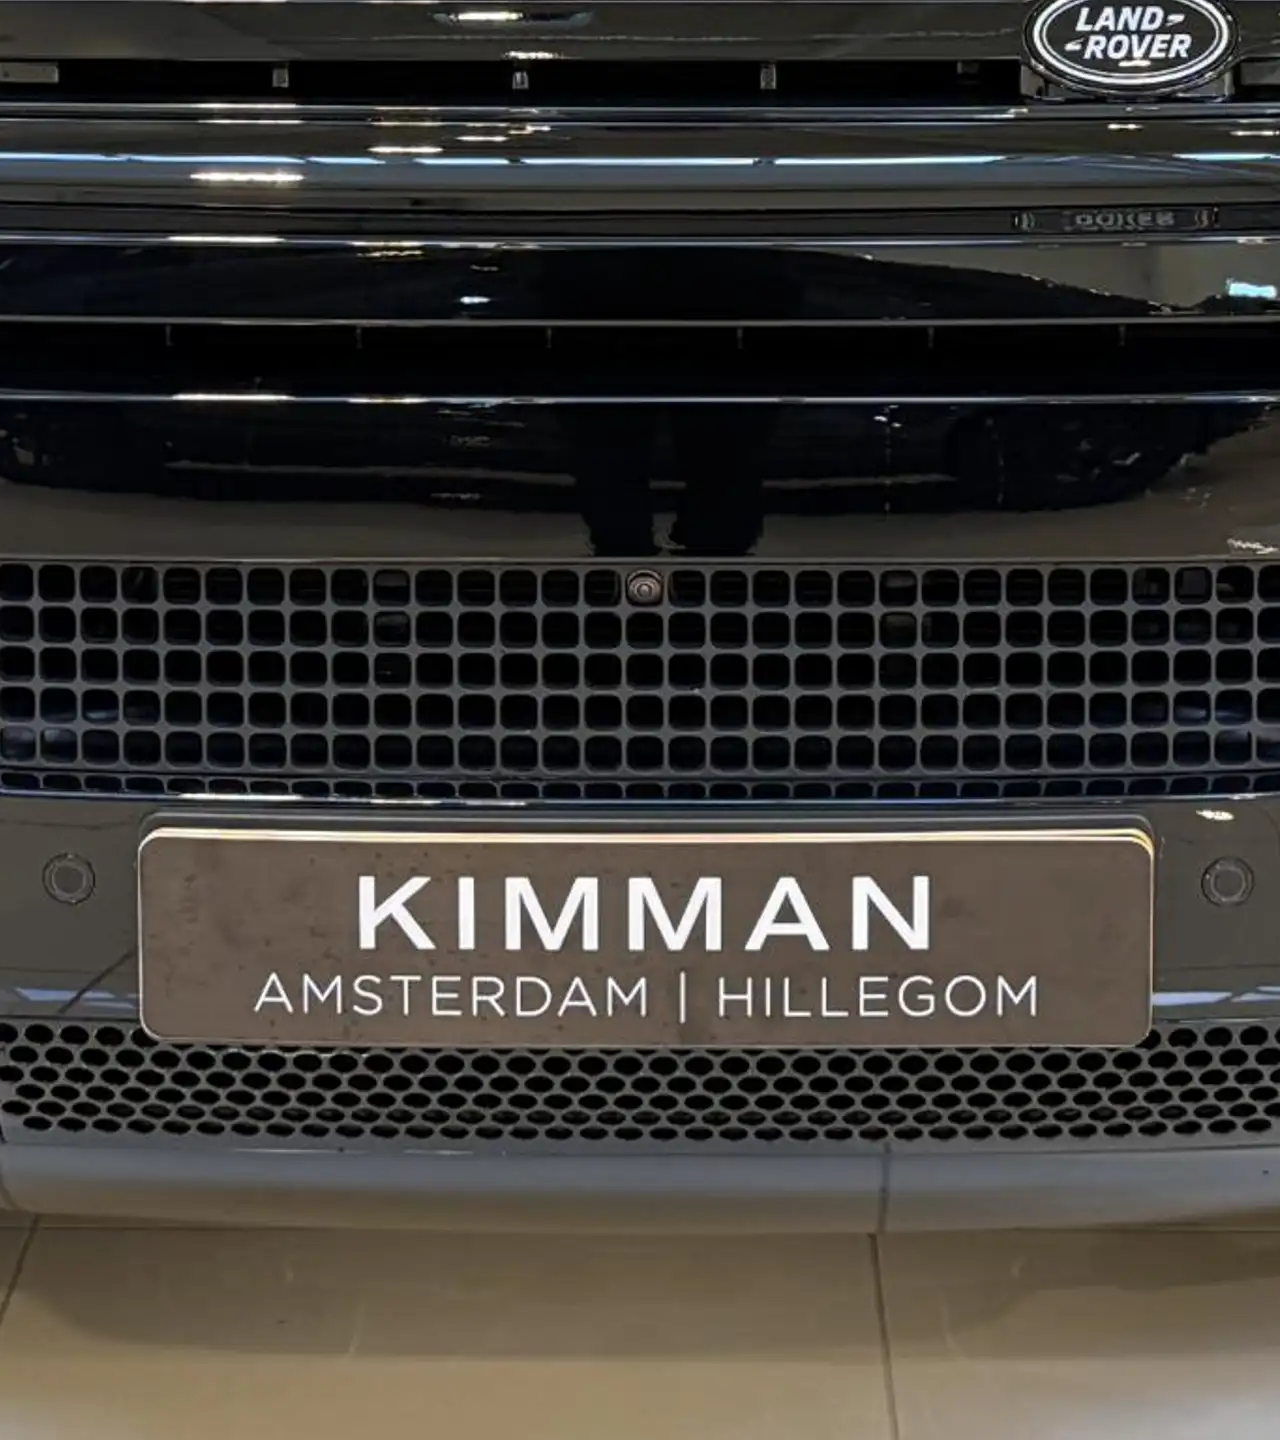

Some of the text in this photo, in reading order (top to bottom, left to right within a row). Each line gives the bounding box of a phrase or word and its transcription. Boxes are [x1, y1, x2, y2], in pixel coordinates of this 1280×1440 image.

[1075, 7, 1165, 32] LAND
[1083, 35, 1193, 59] ROVER
[357, 875, 931, 952] KIMMAN
[254, 973, 1039, 1019] AMSTERDAM HILLEGOM
